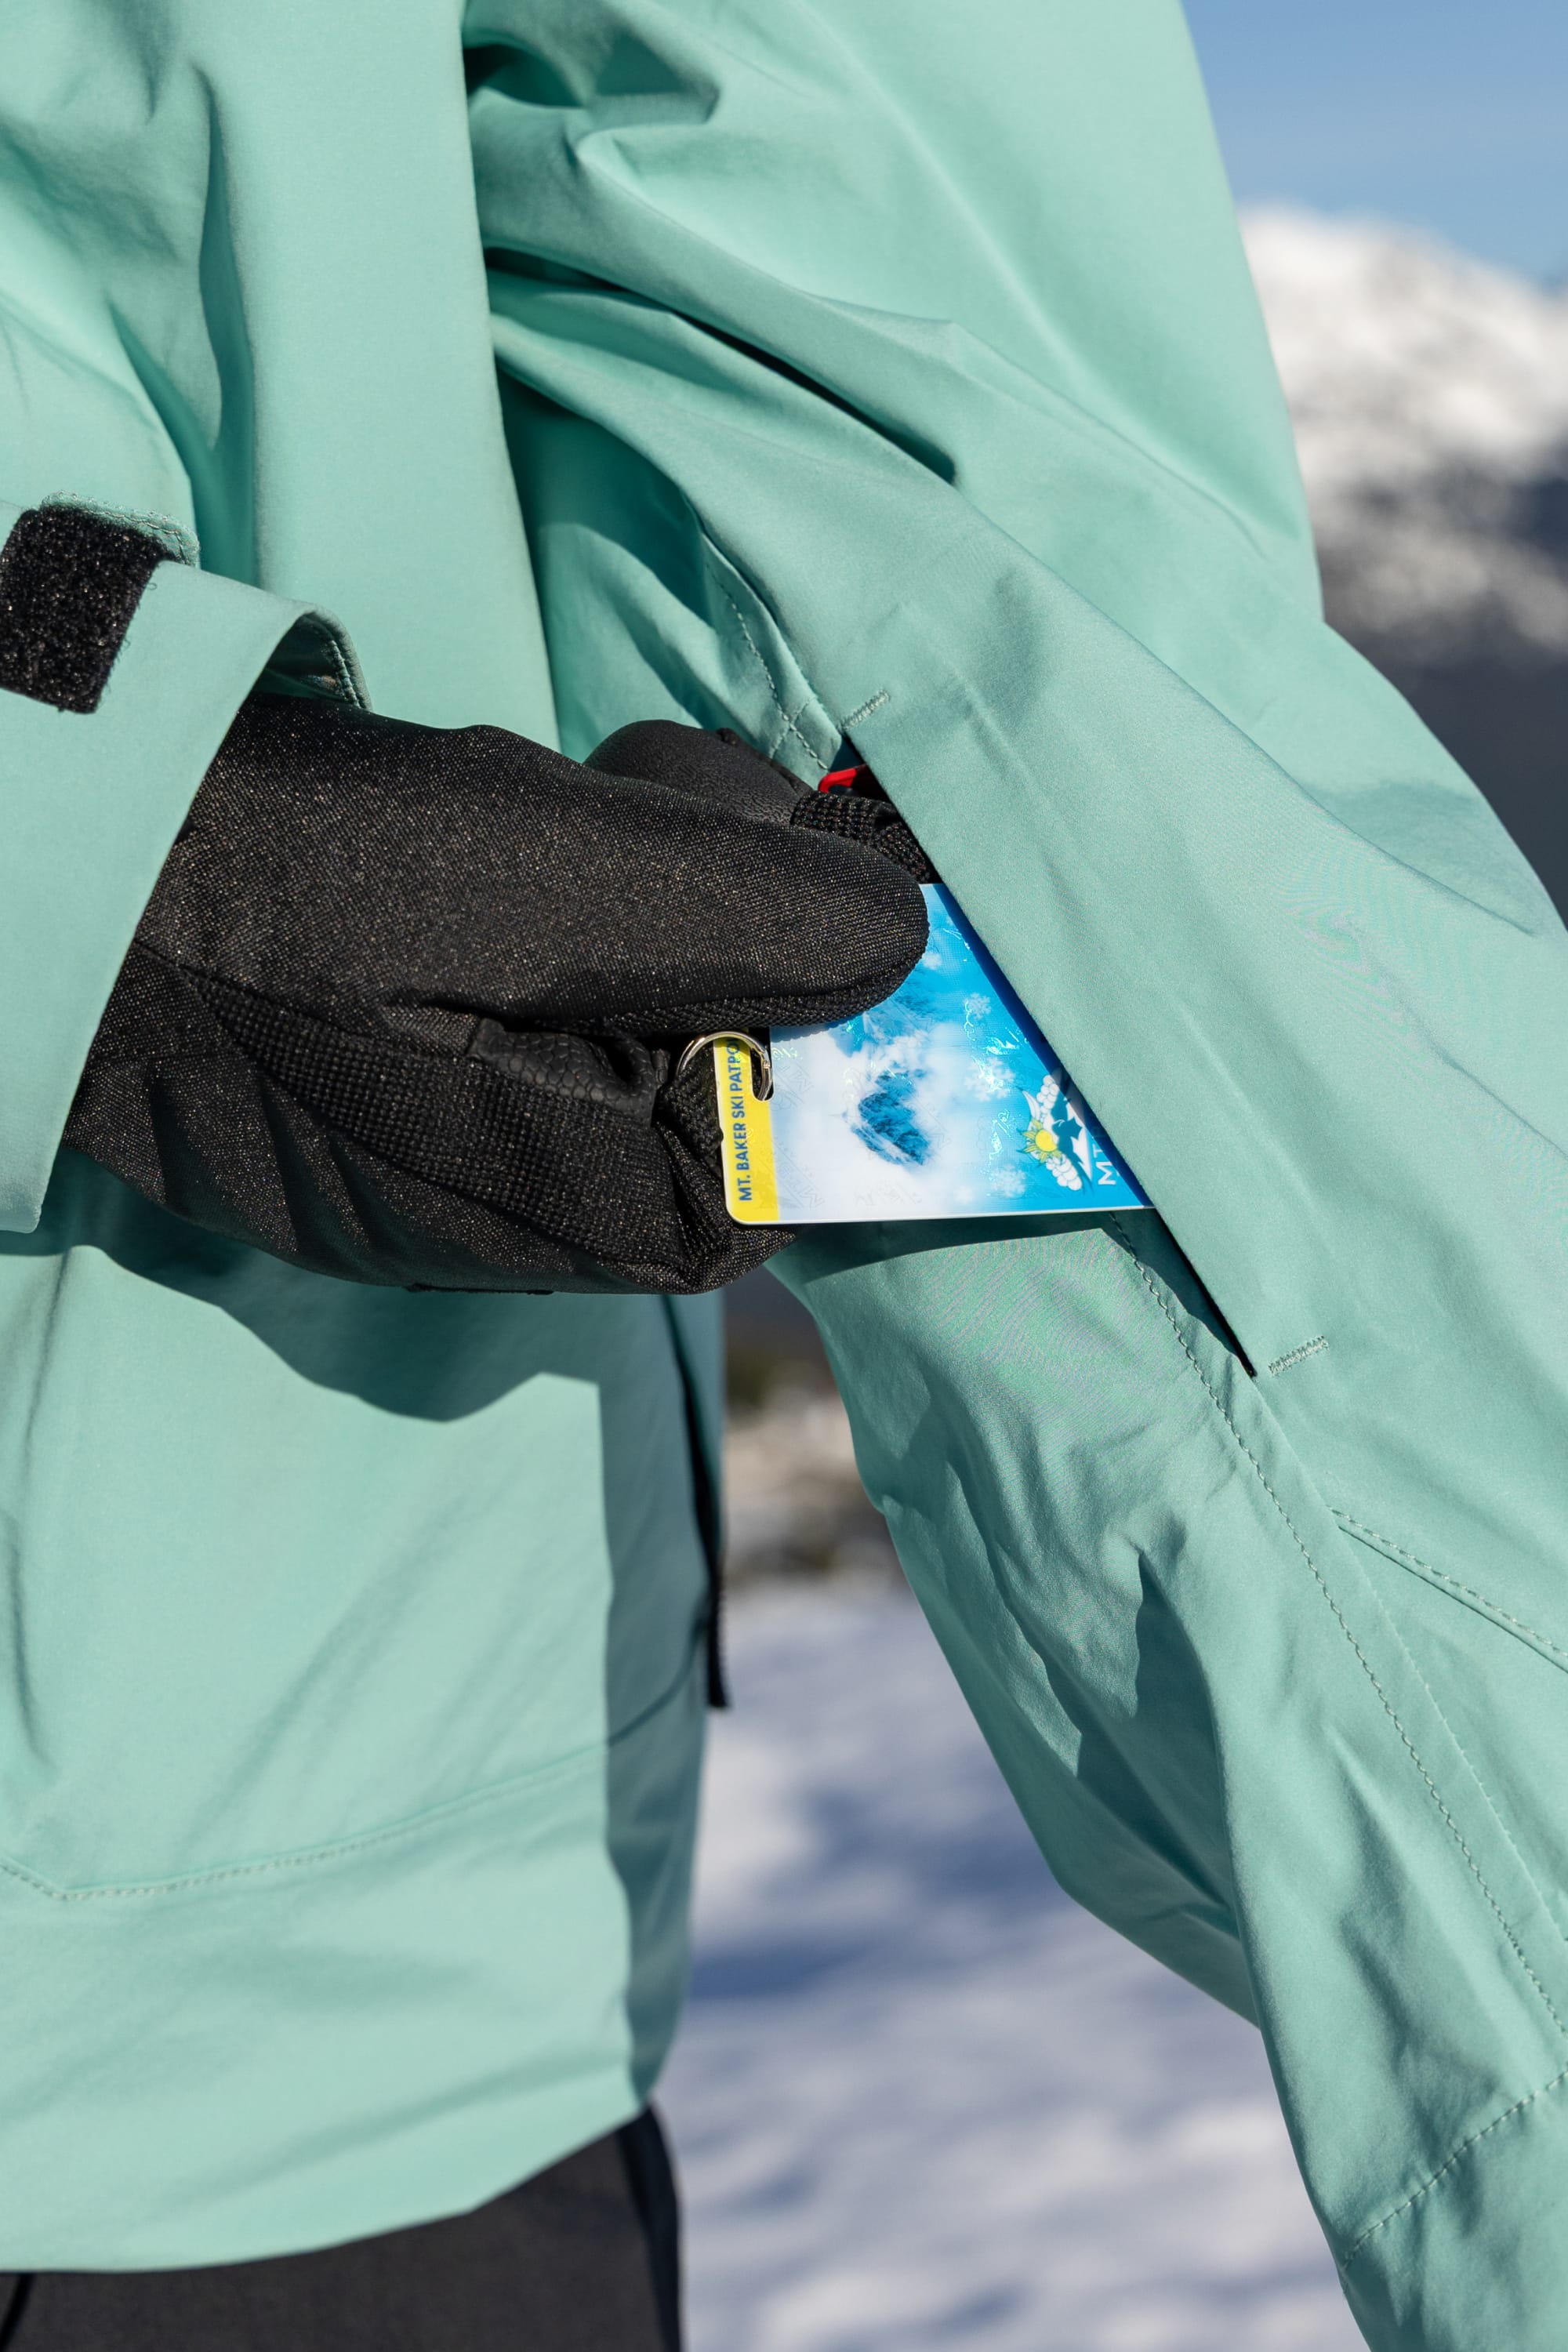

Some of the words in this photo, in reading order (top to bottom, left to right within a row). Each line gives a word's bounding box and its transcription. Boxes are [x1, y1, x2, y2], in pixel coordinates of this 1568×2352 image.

[730, 1095, 746, 1119] SKI
[733, 1122, 750, 1171] BAKER
[737, 1174, 753, 1201] MT.
